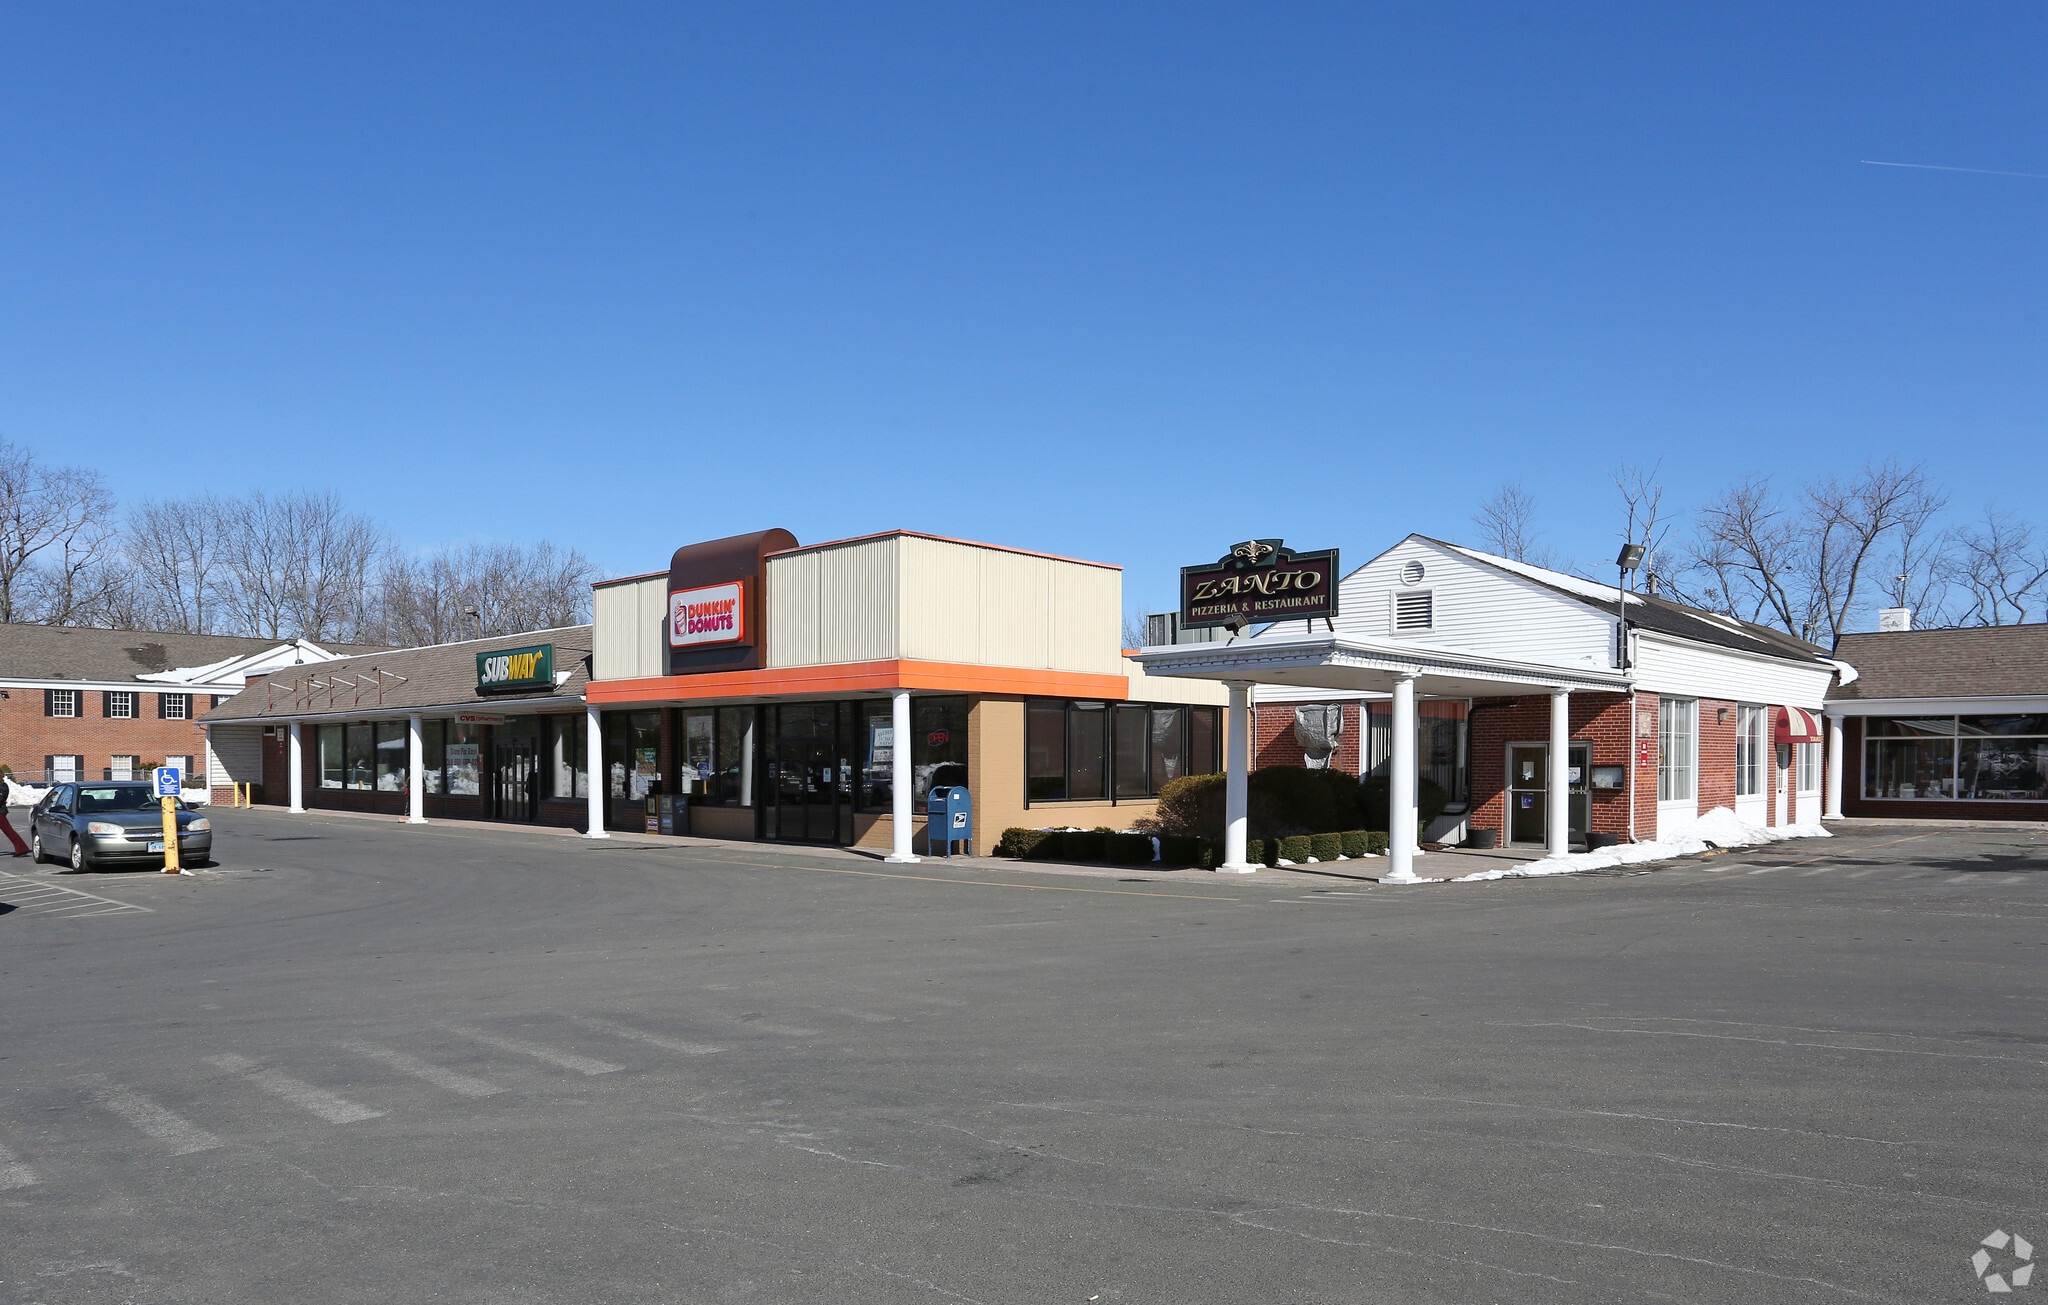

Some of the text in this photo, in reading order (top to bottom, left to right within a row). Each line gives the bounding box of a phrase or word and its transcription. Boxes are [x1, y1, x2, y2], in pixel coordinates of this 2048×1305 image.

[1192, 570, 1321, 600] ZANTO
[688, 598, 736, 618] DUNKIN'
[1192, 595, 1325, 616] PIZZERIA & RESTAURANT
[688, 614, 733, 634] DONUTS
[481, 650, 543, 684] SUBWAY
[927, 732, 949, 744] OPEN
